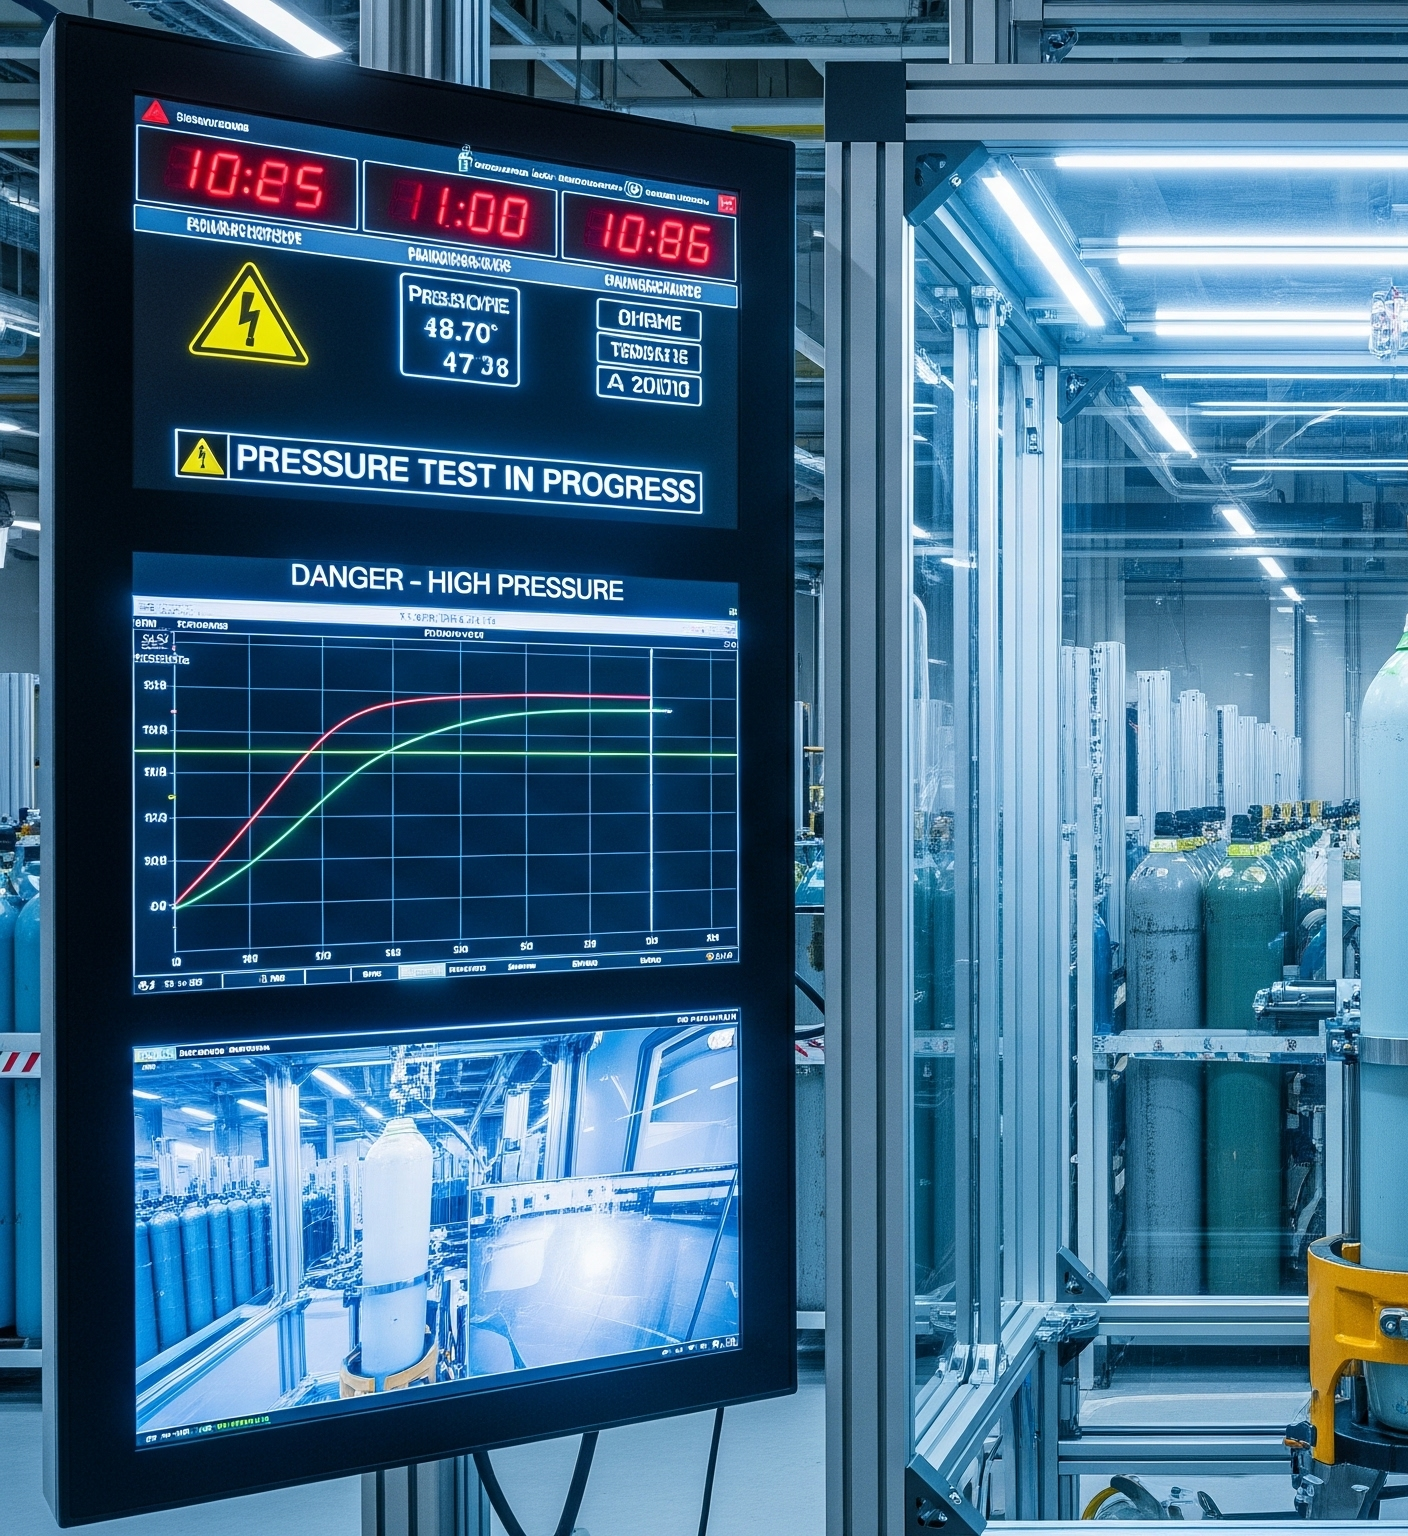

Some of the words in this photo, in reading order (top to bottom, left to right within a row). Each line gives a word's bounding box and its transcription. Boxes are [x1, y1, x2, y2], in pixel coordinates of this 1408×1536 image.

[411, 182, 529, 239] 11:00
[603, 212, 711, 264] 10:86
[237, 444, 409, 483] PRESSURE
[417, 457, 497, 489] TEST
[504, 464, 534, 492] IN
[543, 468, 696, 504] PROGRESS
[291, 562, 404, 591] DANGER
[428, 570, 491, 595] HIGH
[498, 573, 624, 601] PRESSURE
